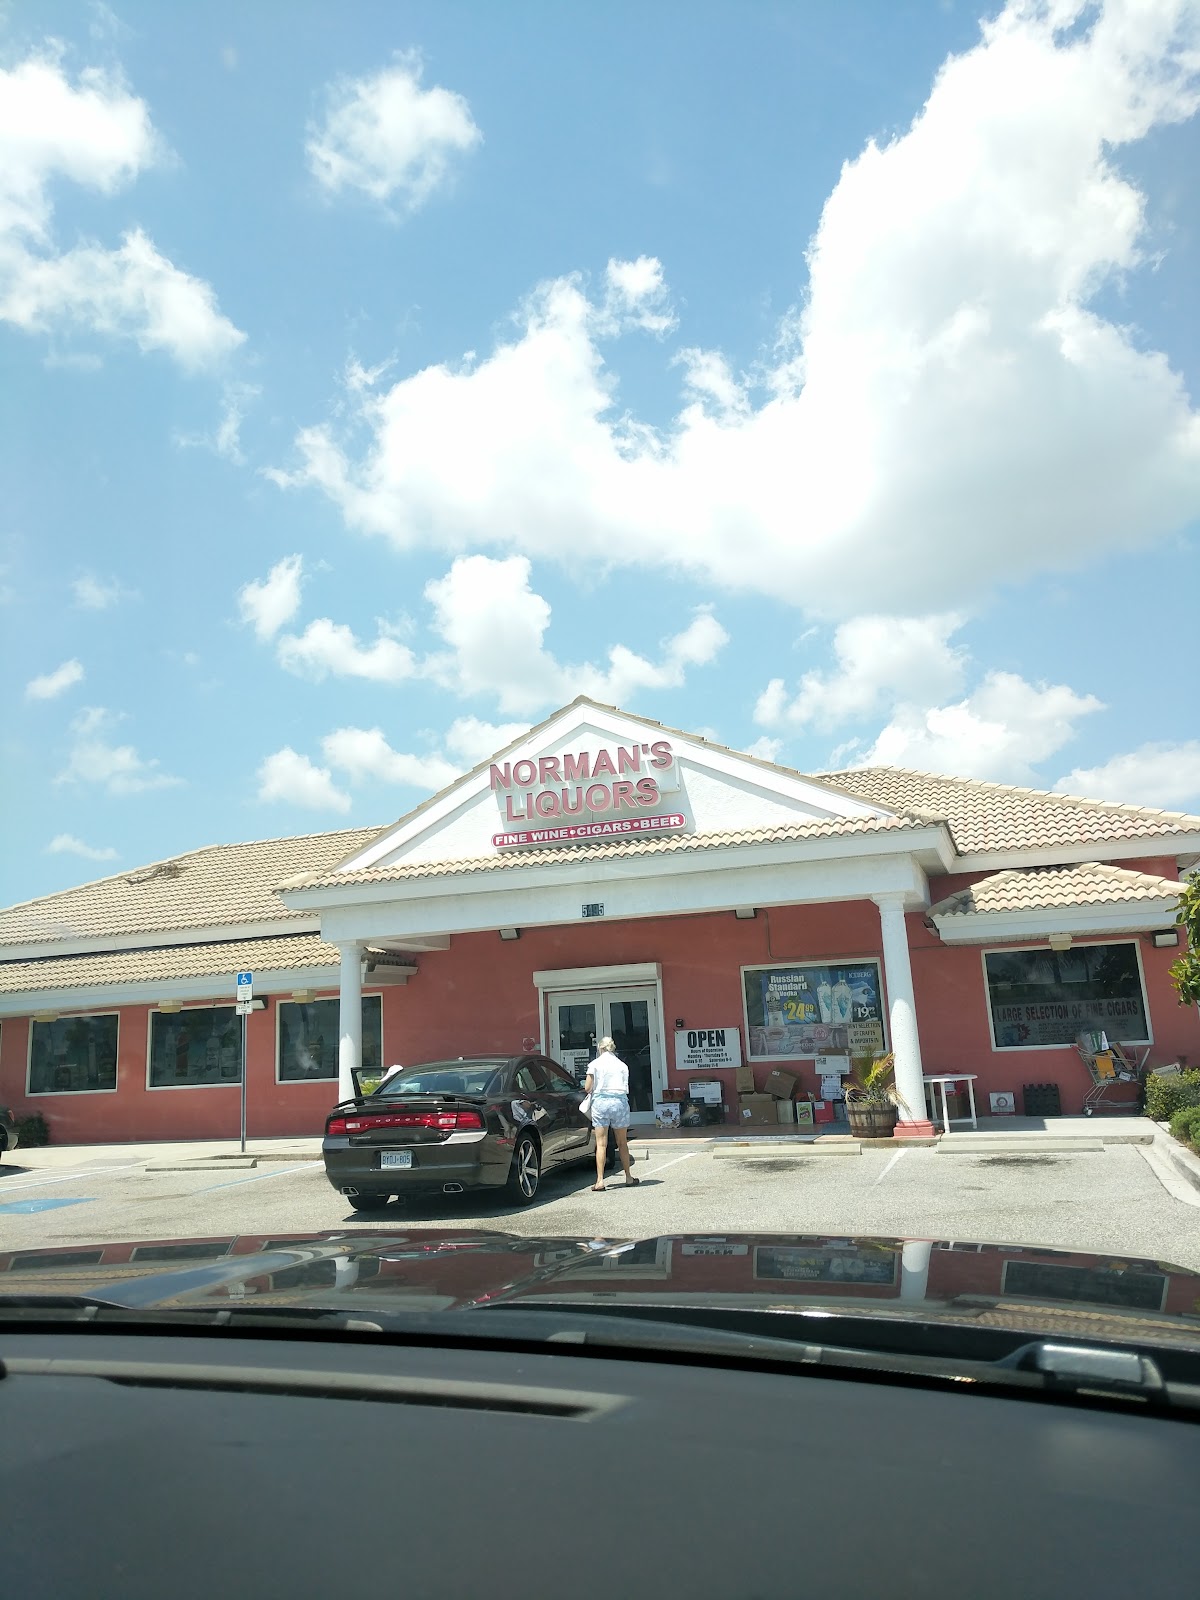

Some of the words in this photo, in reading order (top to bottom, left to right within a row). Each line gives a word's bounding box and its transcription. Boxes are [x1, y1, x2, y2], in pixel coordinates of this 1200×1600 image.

[489, 741, 673, 790] NORMAN'S
[505, 777, 660, 821] LIQUORS
[495, 833, 528, 845] FINE
[531, 830, 568, 842] WINE
[576, 822, 632, 836] CIGARS
[639, 815, 681, 829] BEER
[582, 903, 604, 917] 5495
[768, 982, 808, 992] Standard
[770, 974, 805, 984] Russian
[996, 1007, 1022, 1022] LARGE
[1025, 1004, 1069, 1020] SELECTION
[1071, 1004, 1082, 1019] OF
[1086, 1002, 1104, 1018] FINE
[1107, 1000, 1139, 1016] CIGARS
[688, 1030, 726, 1048] OPEN
